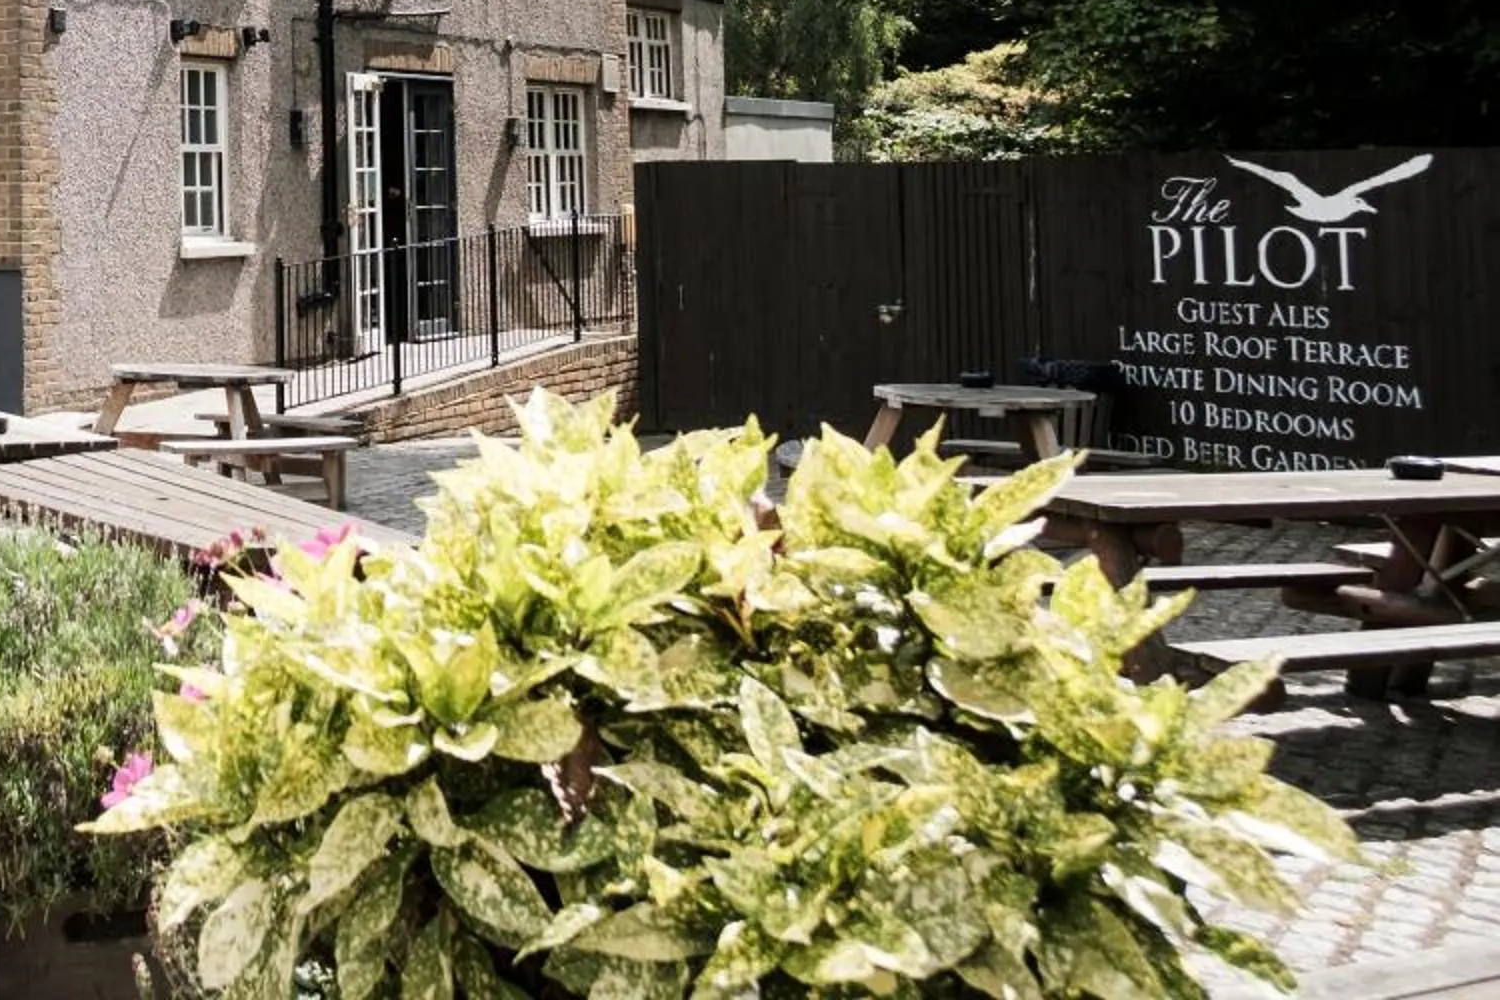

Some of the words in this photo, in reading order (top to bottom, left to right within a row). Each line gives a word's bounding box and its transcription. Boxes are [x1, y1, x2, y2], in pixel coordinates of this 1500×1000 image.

[1151, 176, 1232, 224] The
[1147, 225, 1367, 291] PILOT
[1177, 297, 1261, 325] GUEST
[1268, 302, 1330, 330] ALES
[1119, 326, 1195, 356] LARGE
[1203, 331, 1277, 360] ROOF
[1284, 336, 1410, 369] TERRACE
[1214, 367, 1318, 401] DINING
[1327, 375, 1422, 409] ROOM
[1170, 400, 1195, 426] 10
[1204, 402, 1355, 441] BEDROOMS
[1182, 436, 1246, 469] BEER
